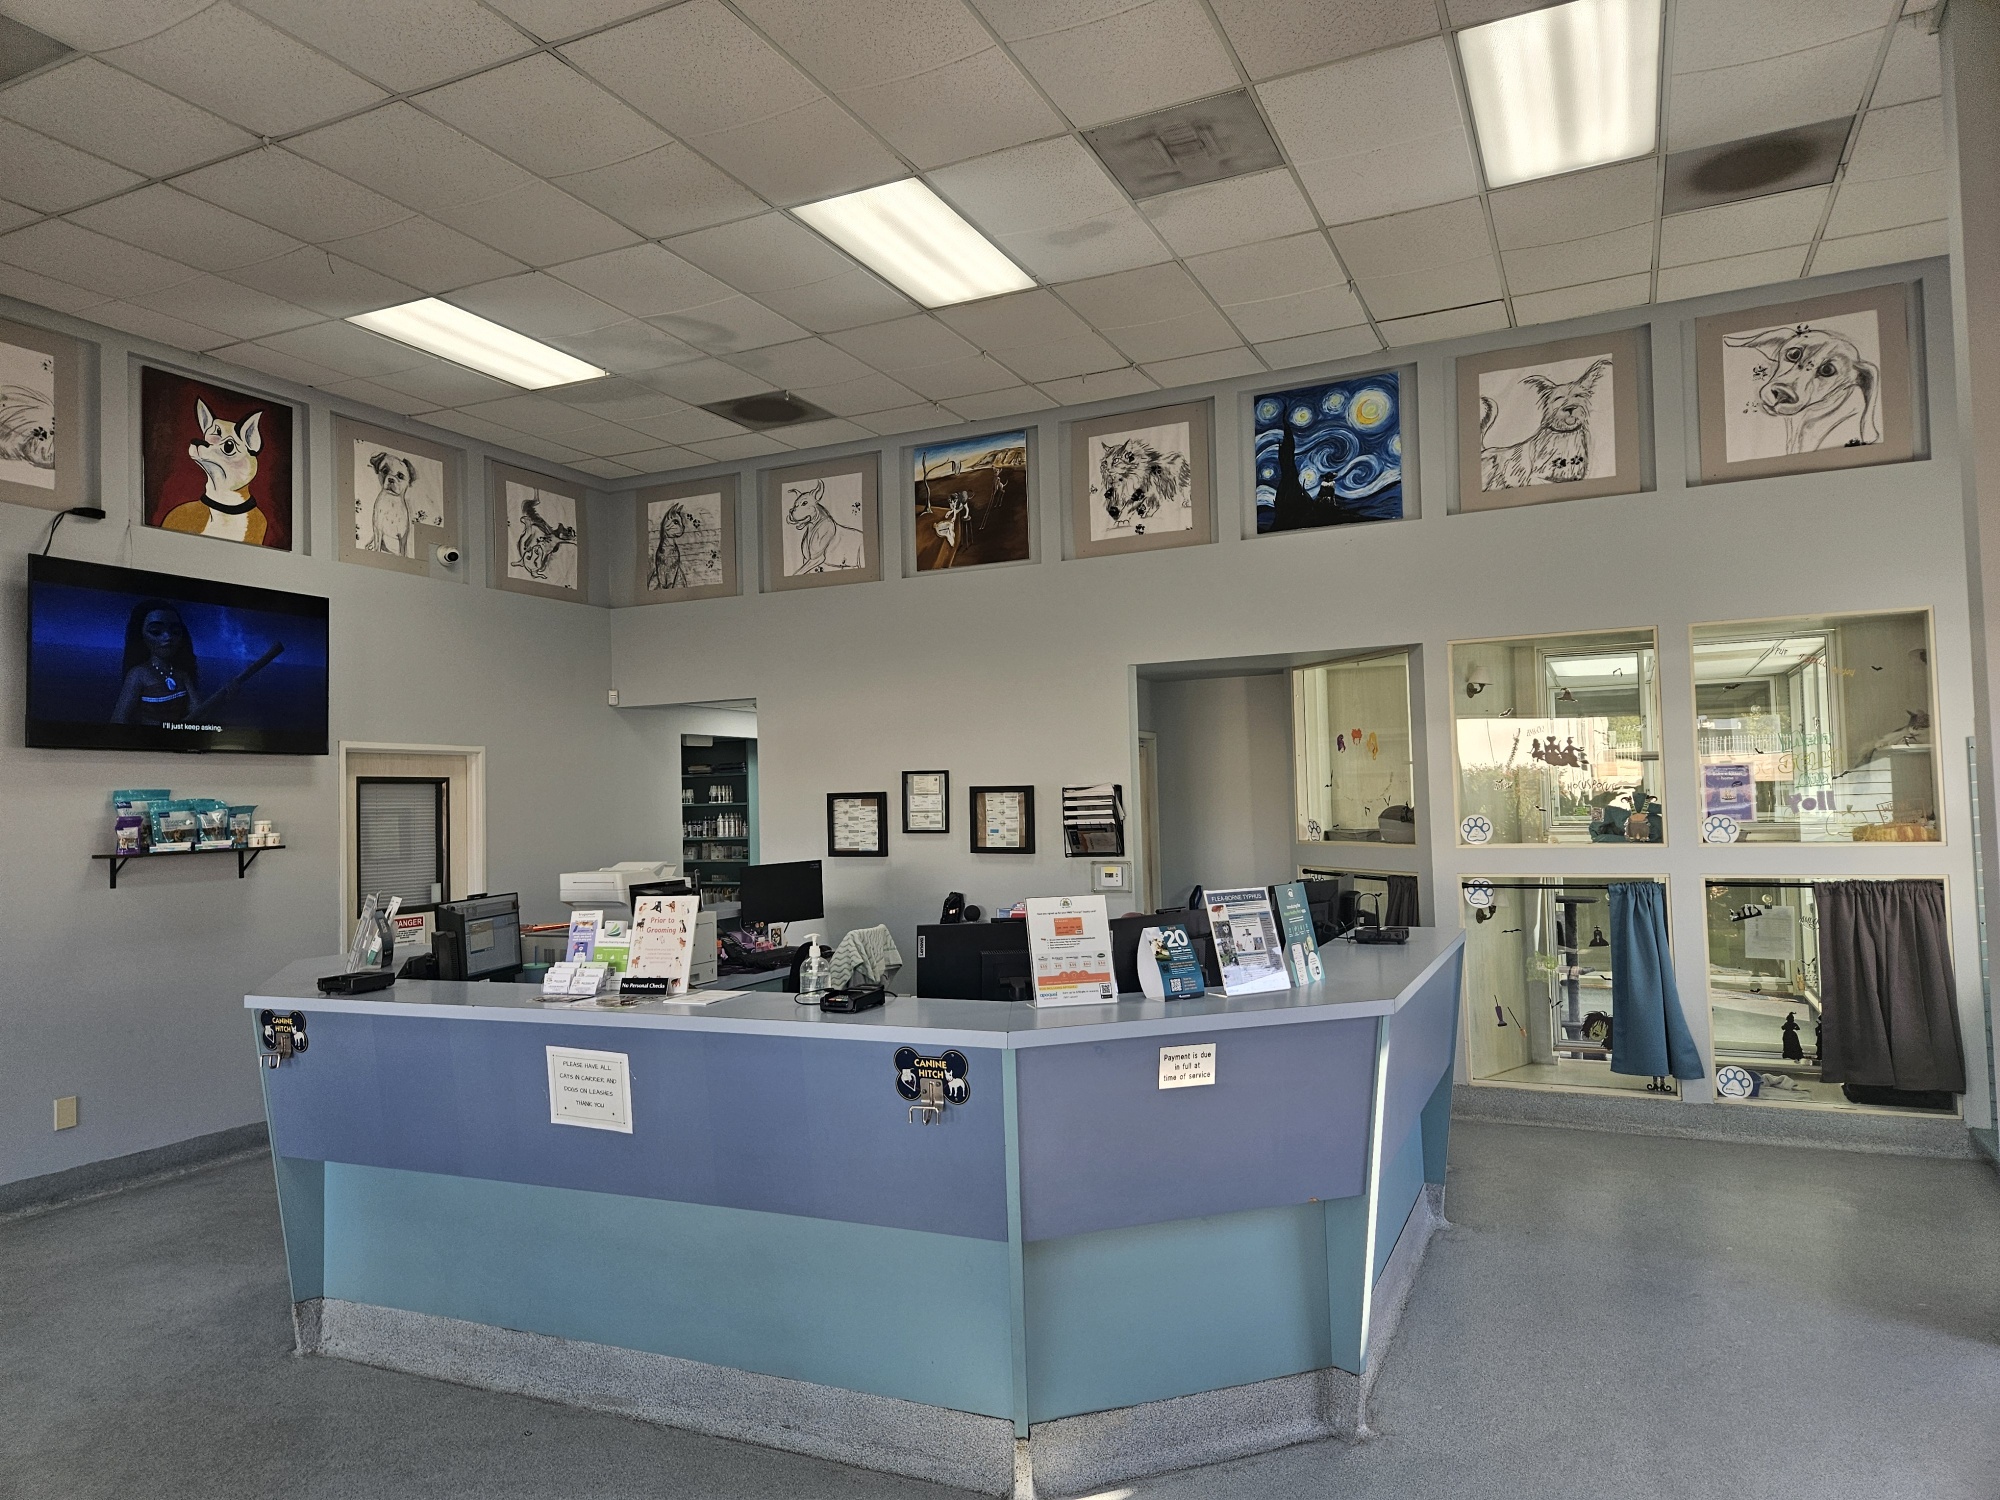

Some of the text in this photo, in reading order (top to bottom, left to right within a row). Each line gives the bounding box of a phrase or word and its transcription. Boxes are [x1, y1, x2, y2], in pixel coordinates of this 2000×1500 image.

[184, 723, 200, 731] keep
[646, 927, 677, 935] Grooming
[272, 1017, 293, 1025] CANINE
[1163, 1053, 1191, 1062] Payment
[1200, 1051, 1212, 1059] due
[914, 1059, 947, 1069] CANINE
[1182, 1062, 1192, 1070] full
[918, 1069, 944, 1079] HITCH
[1188, 1071, 1211, 1079] service
[588, 1089, 614, 1097] LEASHES
